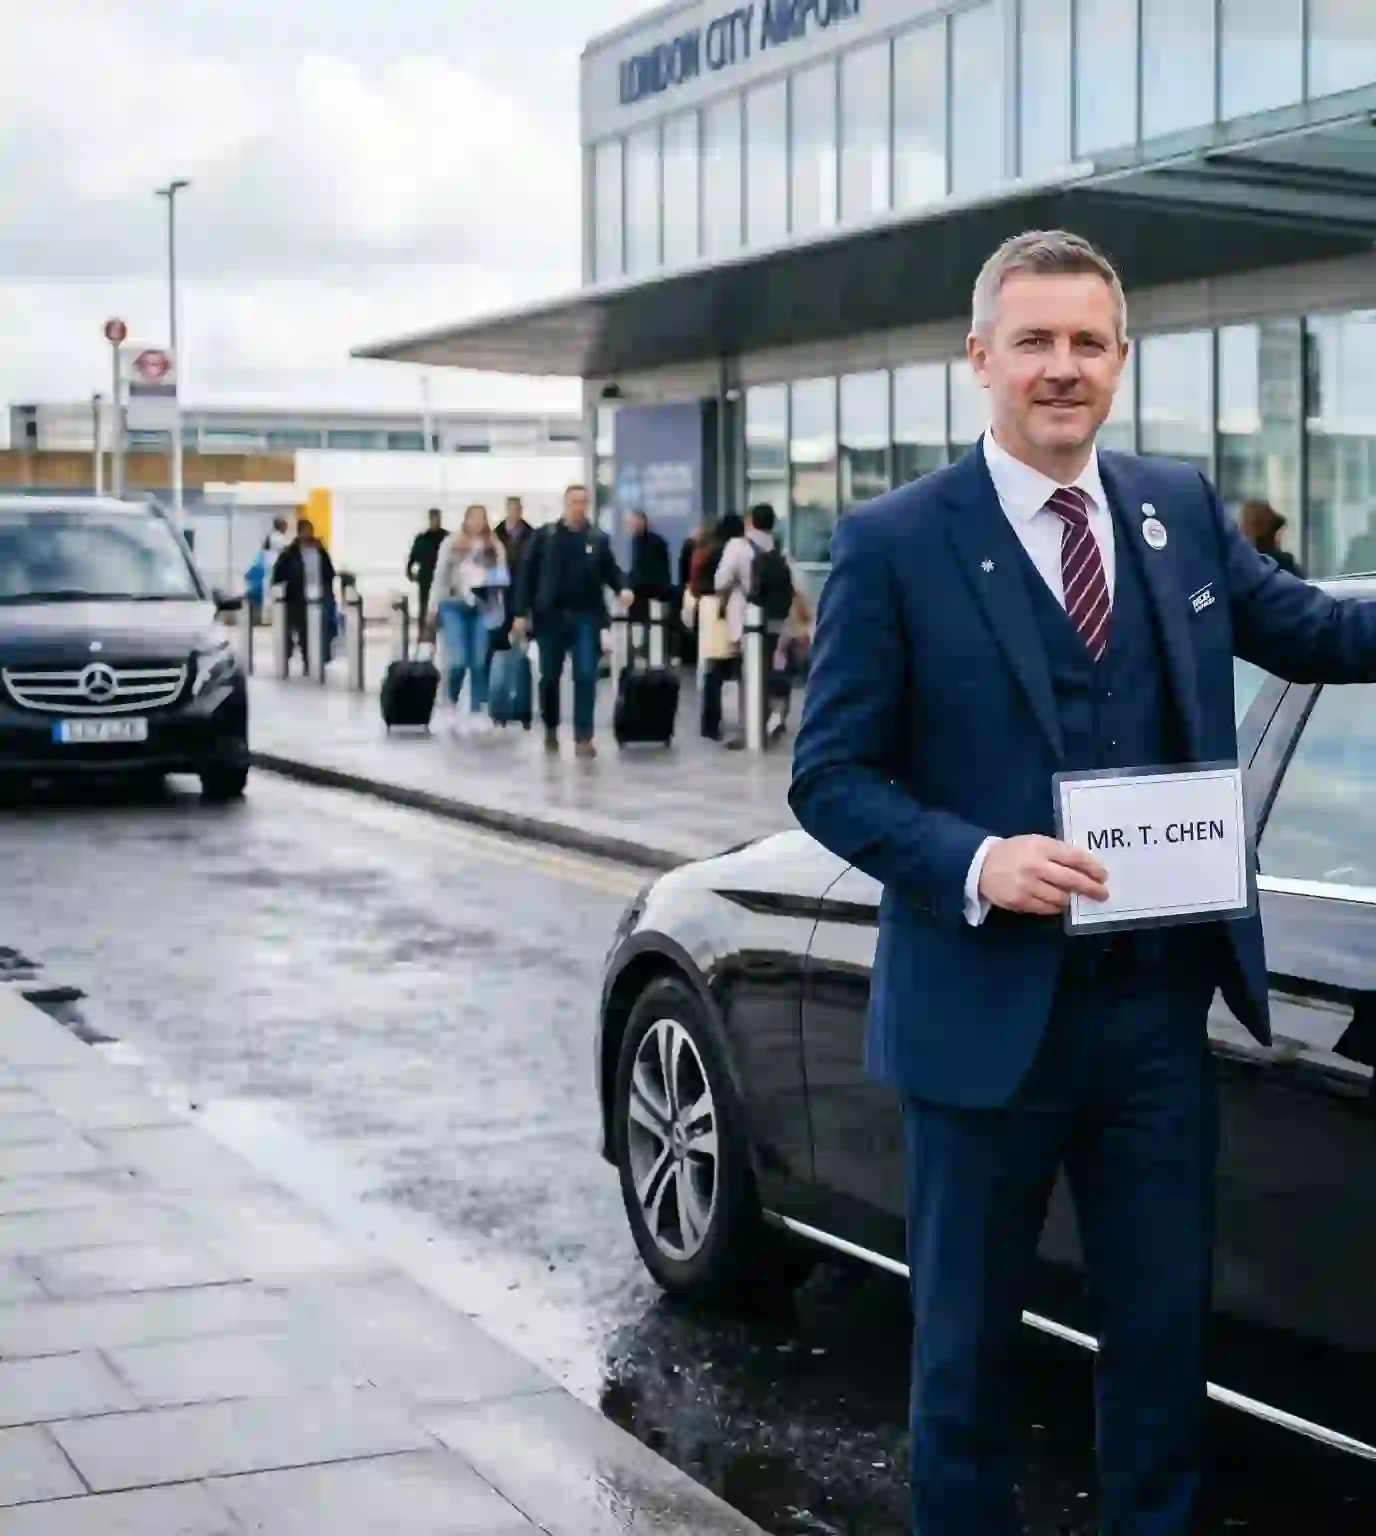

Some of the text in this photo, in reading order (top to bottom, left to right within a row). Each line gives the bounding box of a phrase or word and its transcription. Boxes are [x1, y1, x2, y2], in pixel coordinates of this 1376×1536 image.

[705, 3, 753, 70] CITY
[1087, 819, 1225, 850] MR. T. CHEN
